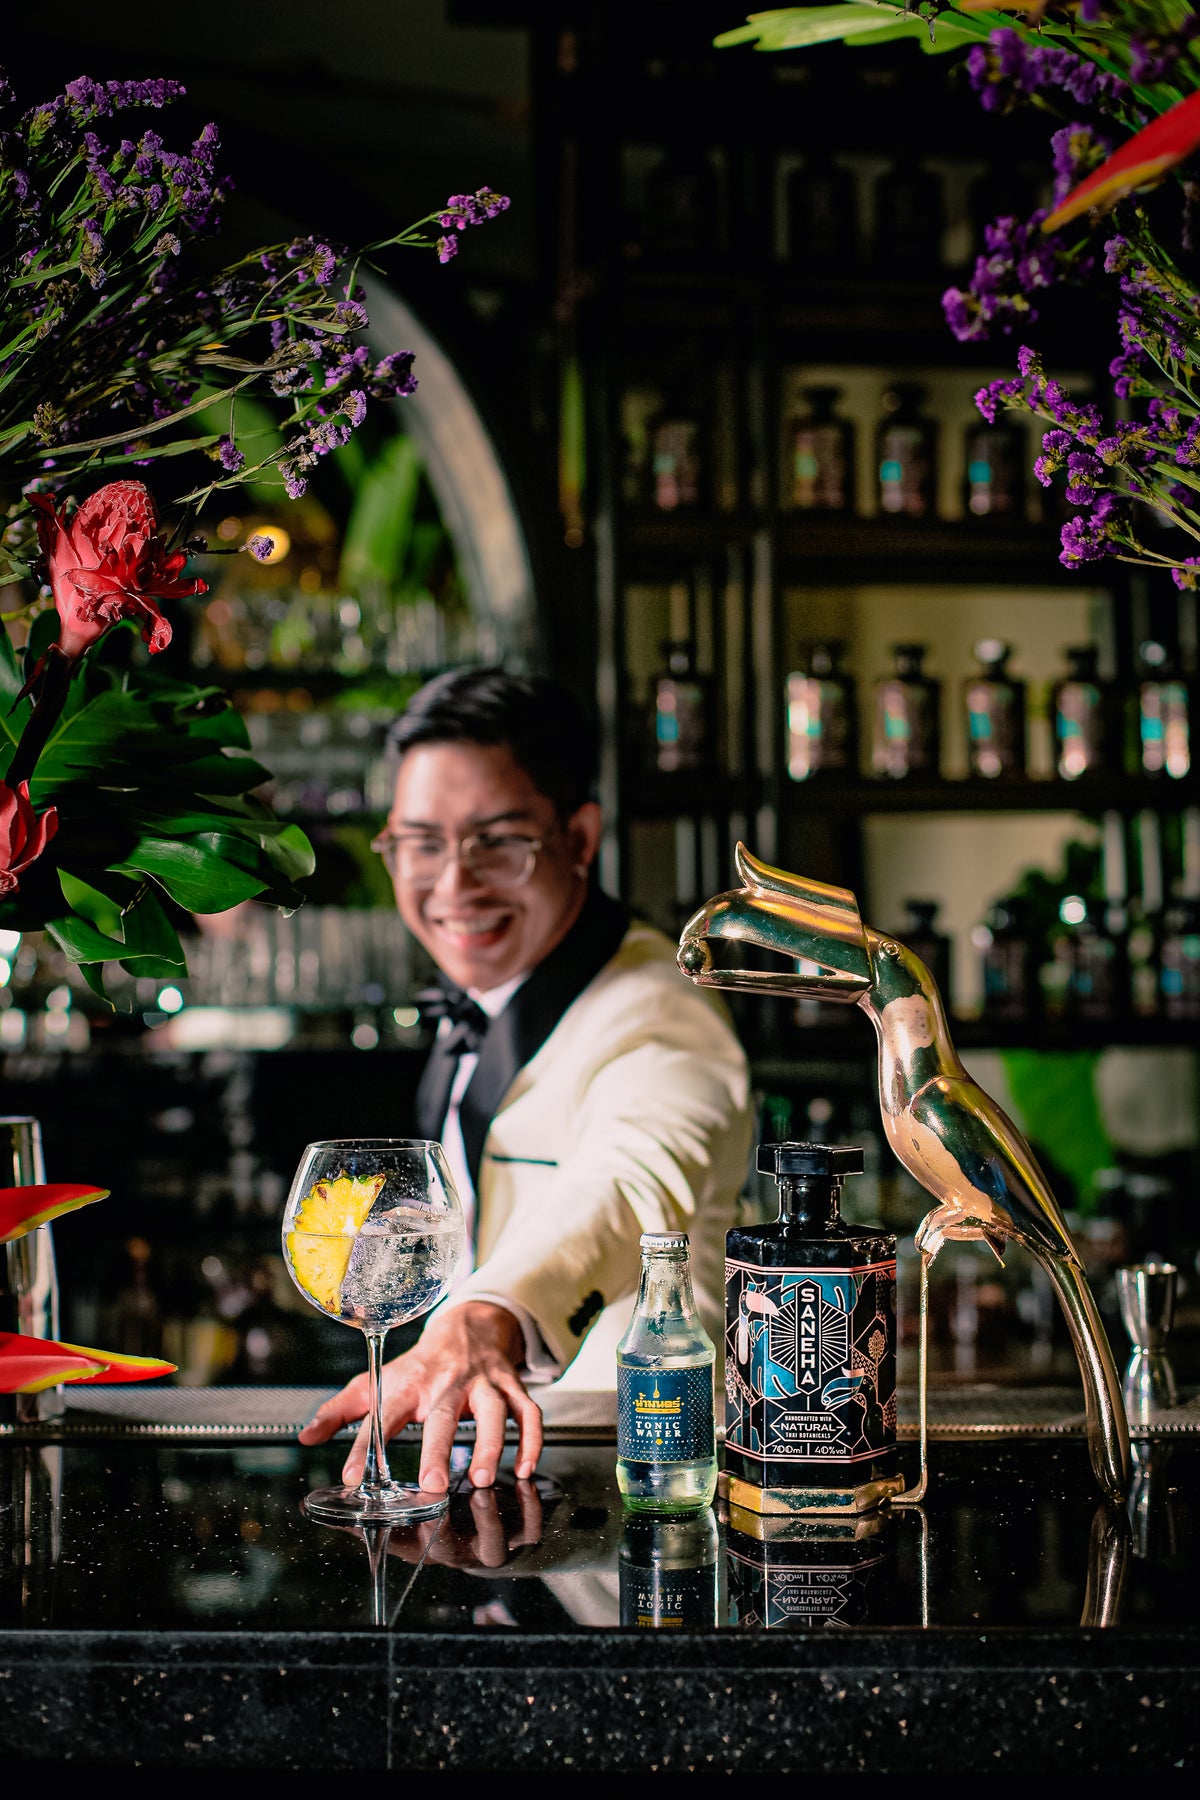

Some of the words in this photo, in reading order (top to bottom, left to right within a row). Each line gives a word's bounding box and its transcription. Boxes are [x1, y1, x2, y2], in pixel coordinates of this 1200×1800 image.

[800, 1288, 816, 1385] SANEHA
[635, 1420, 680, 1430] TONIC
[780, 1422, 837, 1432] NATURAL
[635, 1428, 682, 1438] WATER
[772, 1444, 803, 1454] 700ml
